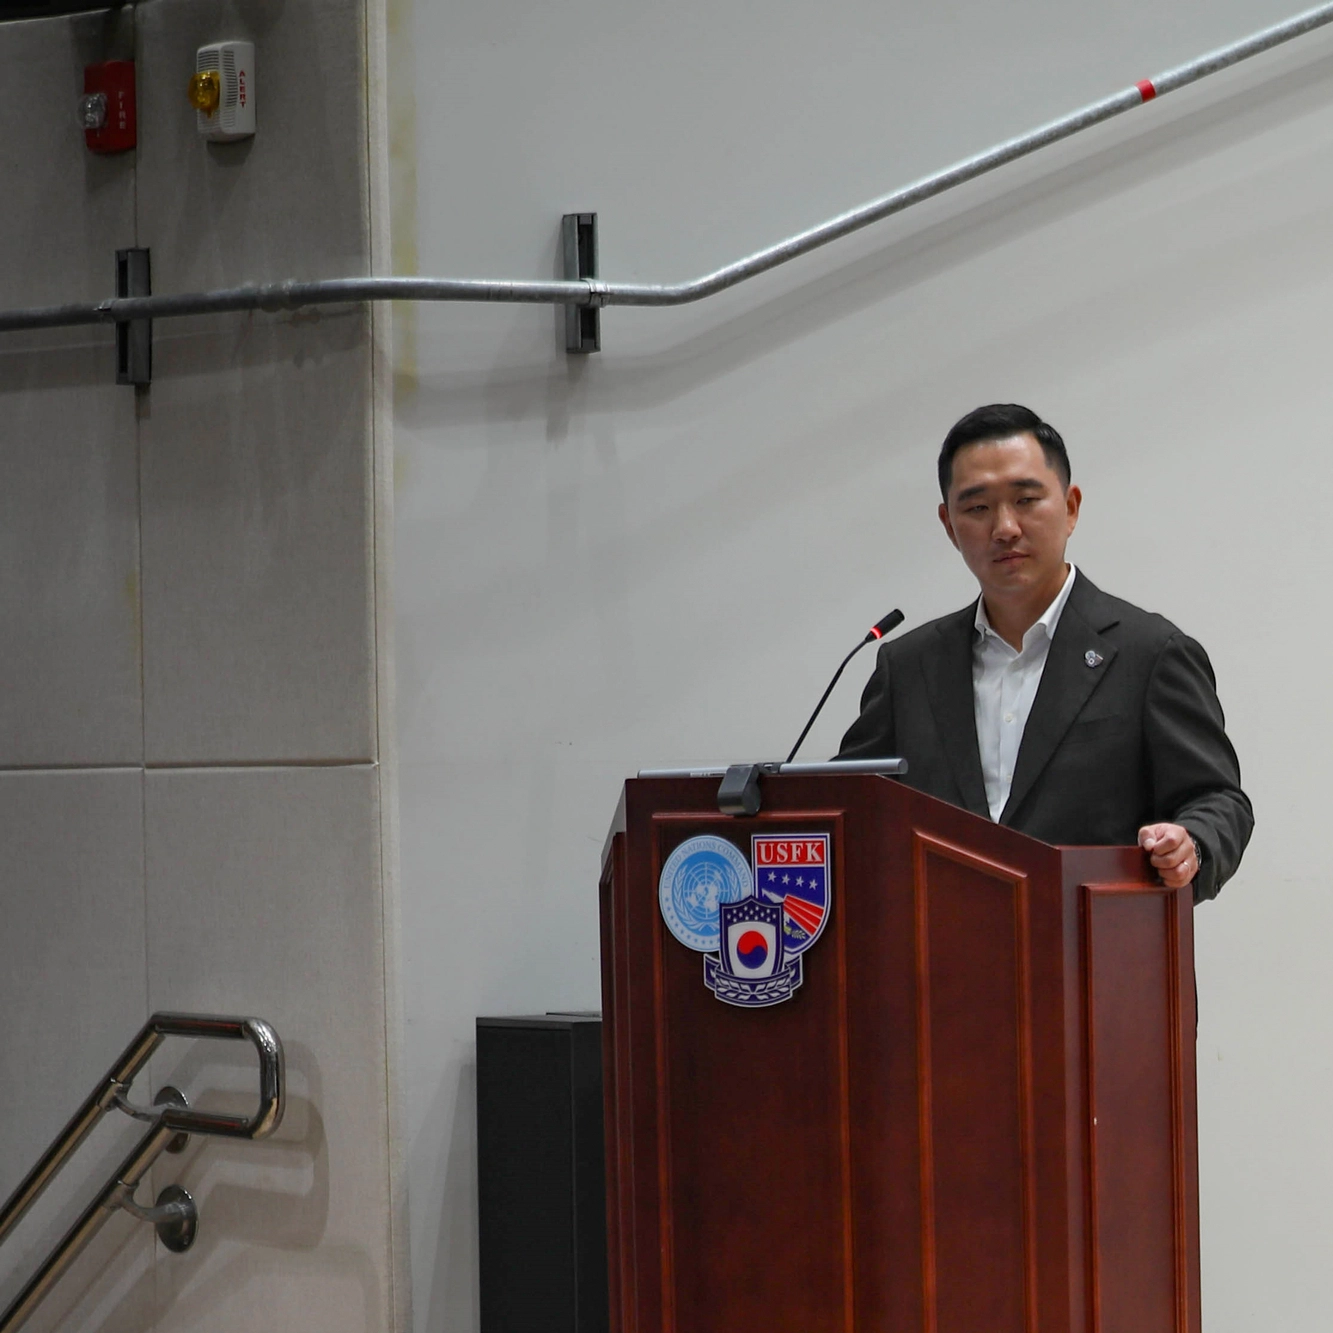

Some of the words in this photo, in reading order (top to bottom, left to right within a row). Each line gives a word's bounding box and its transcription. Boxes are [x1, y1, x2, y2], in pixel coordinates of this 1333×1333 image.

[239, 70, 247, 108] ALERT
[118, 91, 127, 130] FIRE
[681, 841, 716, 857] NATIONS
[717, 845, 749, 888] COMMAND
[759, 842, 822, 863] USFK
